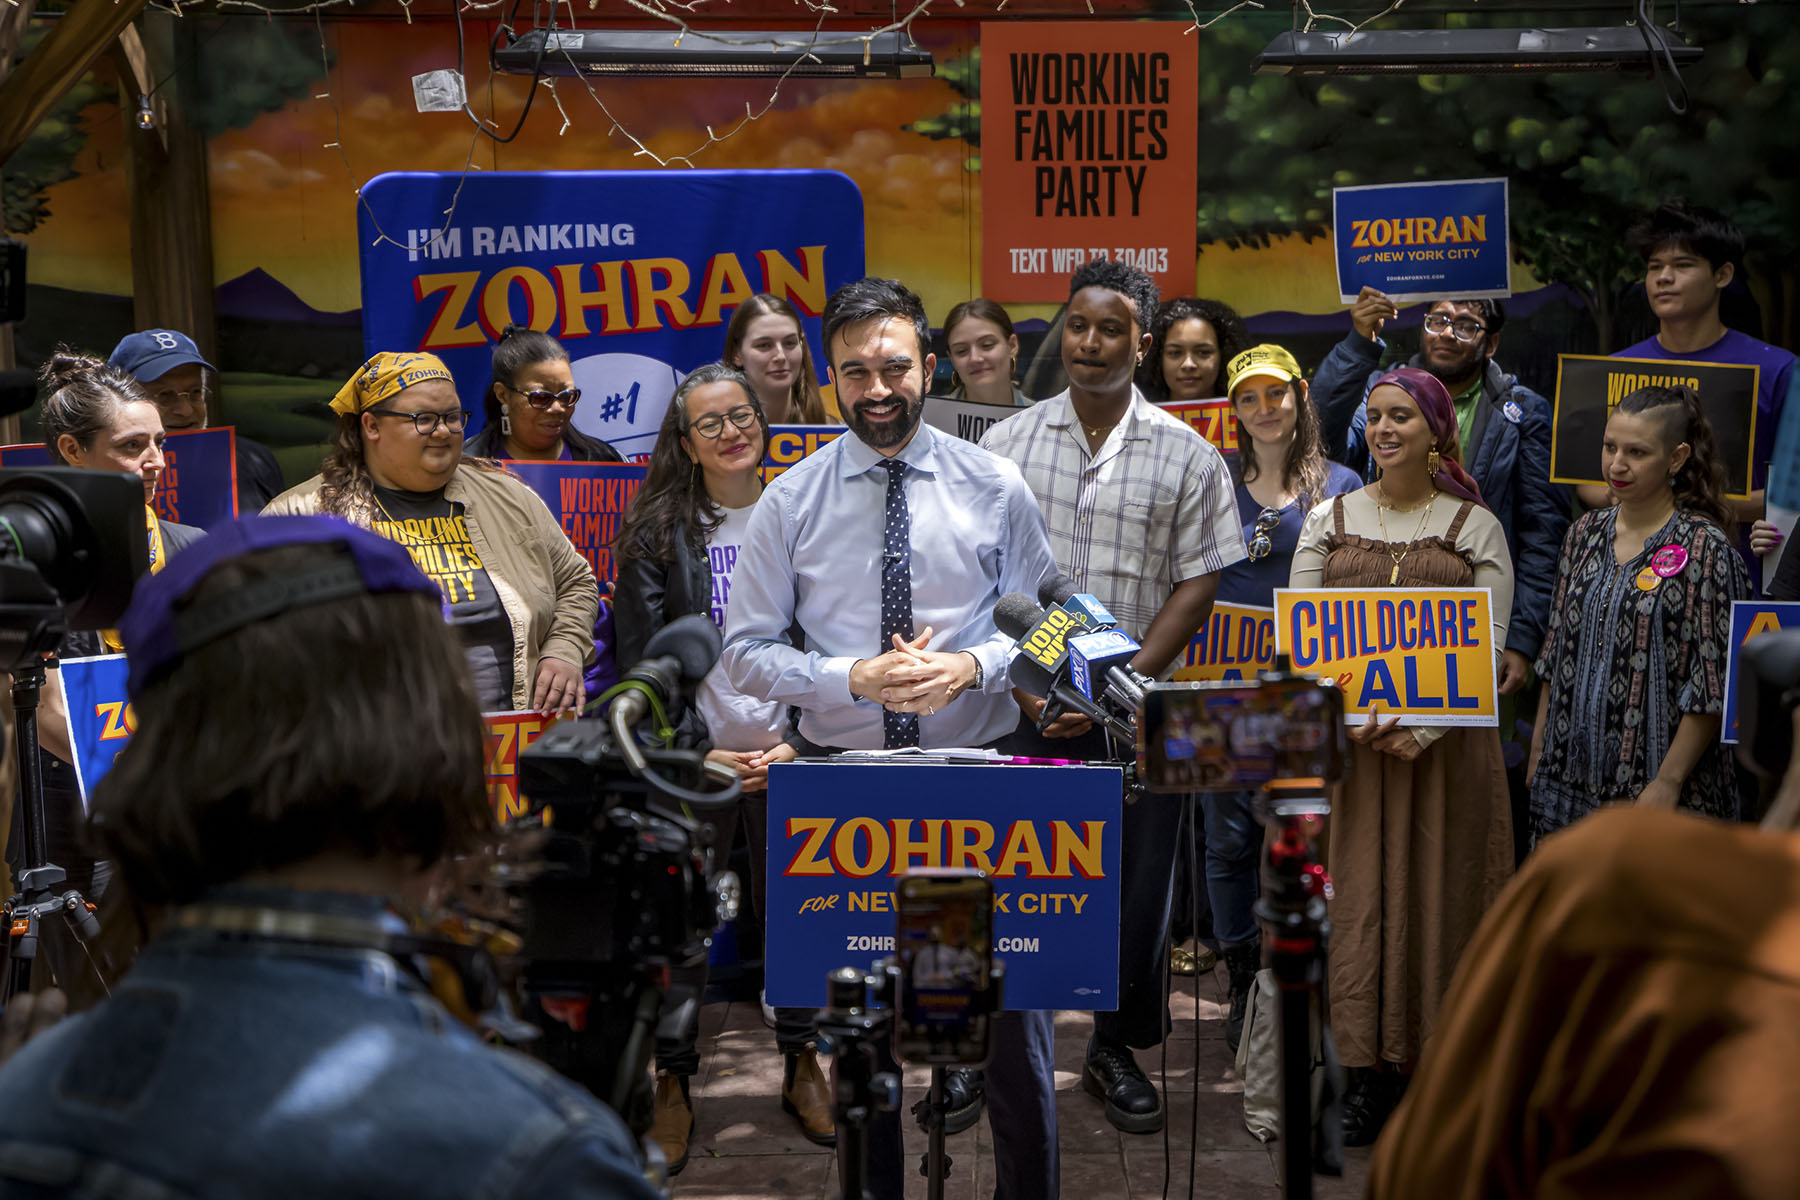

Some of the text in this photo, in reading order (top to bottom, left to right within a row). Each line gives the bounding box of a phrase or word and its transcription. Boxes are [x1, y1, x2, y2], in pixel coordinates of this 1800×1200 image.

[1010, 52, 1170, 105] WORKING
[1014, 109, 1168, 161] FAMILIES
[1034, 166, 1147, 217] PARTY
[407, 224, 634, 262] I'M RANKING
[1351, 214, 1488, 249] ZOHRAN
[1009, 247, 1048, 274] TEXT
[1051, 247, 1085, 273] WFP
[1356, 248, 1481, 265] FOR NEW YORK CITY
[412, 245, 828, 352] ZOHRAN
[600, 381, 641, 424] #1
[1022, 610, 1069, 656] 1010
[1290, 600, 1480, 669] CHILDCARE
[1357, 653, 1479, 708] ALL
[782, 817, 1107, 879] ZOHRAN
[799, 894, 840, 915] FOR
[848, 892, 899, 912] NE
[1018, 893, 1089, 914] CITY
